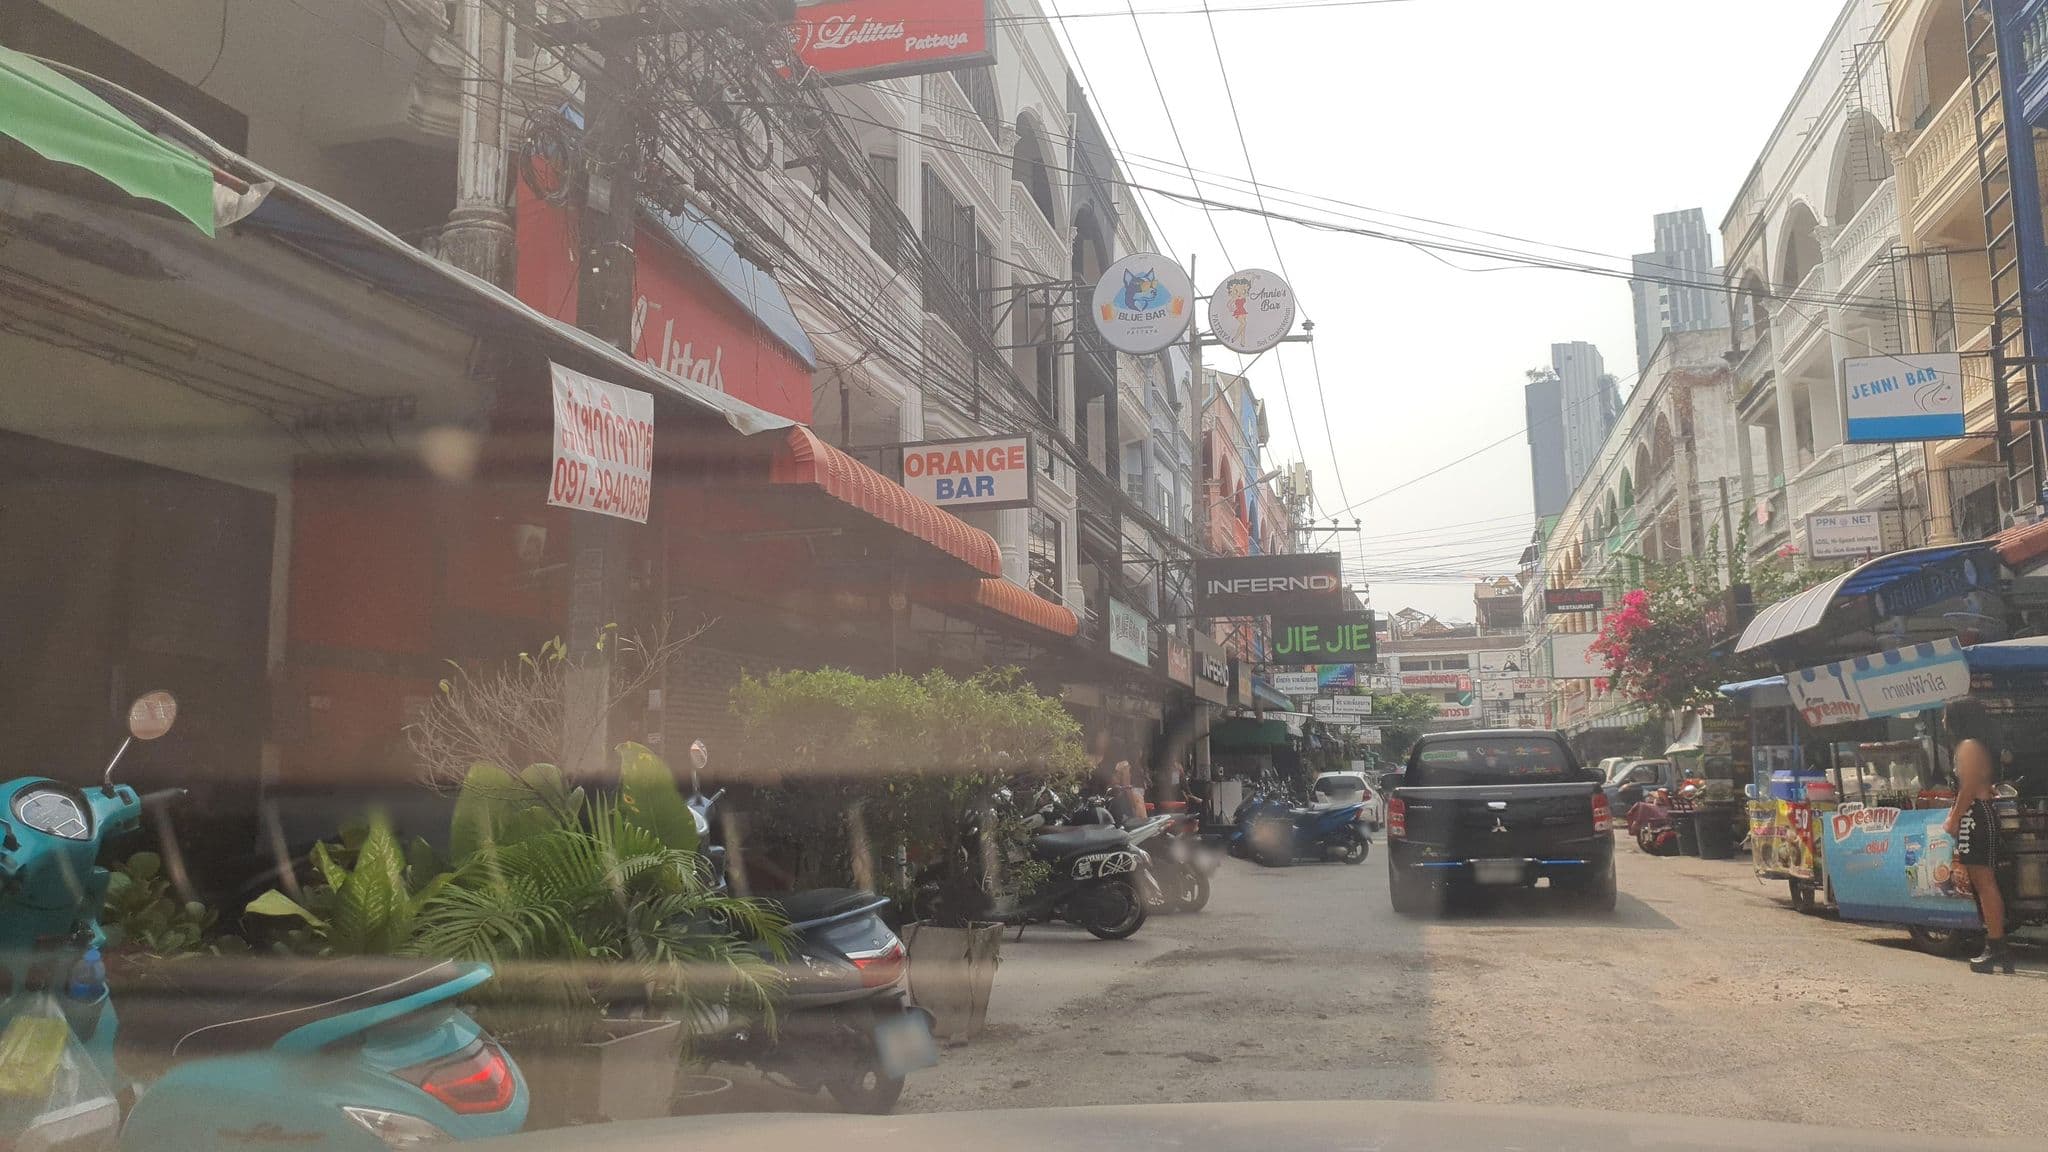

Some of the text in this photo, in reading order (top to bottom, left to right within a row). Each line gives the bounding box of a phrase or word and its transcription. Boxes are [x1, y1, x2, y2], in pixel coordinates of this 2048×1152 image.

[813, 15, 968, 52] Lolitas Pattaya
[1250, 287, 1287, 300] Annie's
[1260, 299, 1281, 312] Bar
[1118, 309, 1167, 322] BLUE BAR
[1851, 367, 1937, 400] JENNI BAR
[905, 445, 1025, 478] ORANGE
[936, 475, 995, 500] BAR
[1815, 514, 1872, 526] PPN NET
[1207, 575, 1331, 594] INFERNO
[1276, 624, 1371, 653] JIE JIE
[1882, 672, 1947, 700] กาแฟฟ้าใส
[1802, 700, 1861, 727] Dreamy
[1832, 808, 1899, 842] Dreamy
